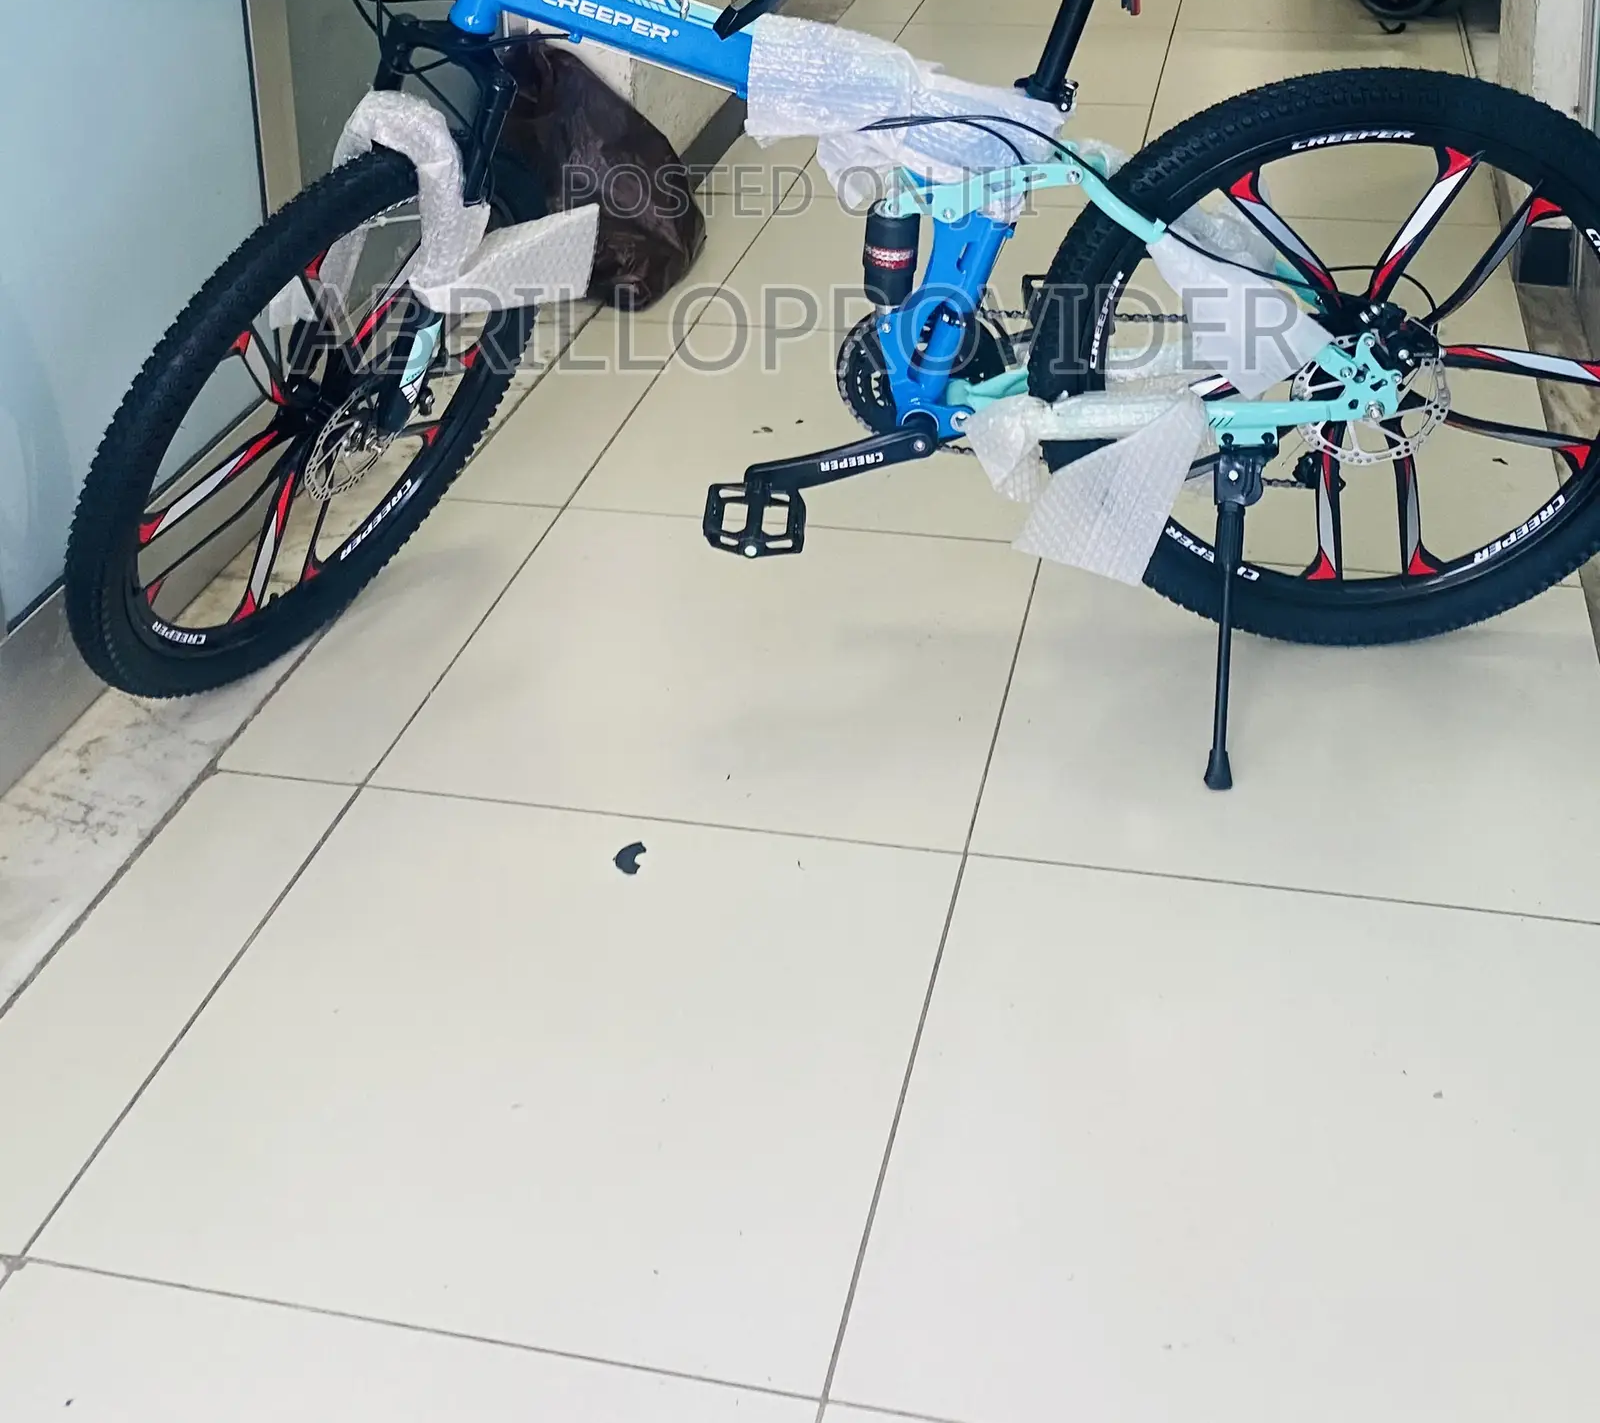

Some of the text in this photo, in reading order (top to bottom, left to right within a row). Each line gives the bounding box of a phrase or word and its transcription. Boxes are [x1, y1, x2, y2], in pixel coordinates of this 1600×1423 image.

[1291, 129, 1415, 151] CREEPER
[1089, 270, 1125, 370] CREEPER
[819, 451, 884, 472] CREEPER
[340, 478, 412, 561] CREEPER
[1473, 494, 1566, 564] CREEPER
[1165, 525, 1260, 581] CEPER
[152, 621, 207, 645] CREEPER
